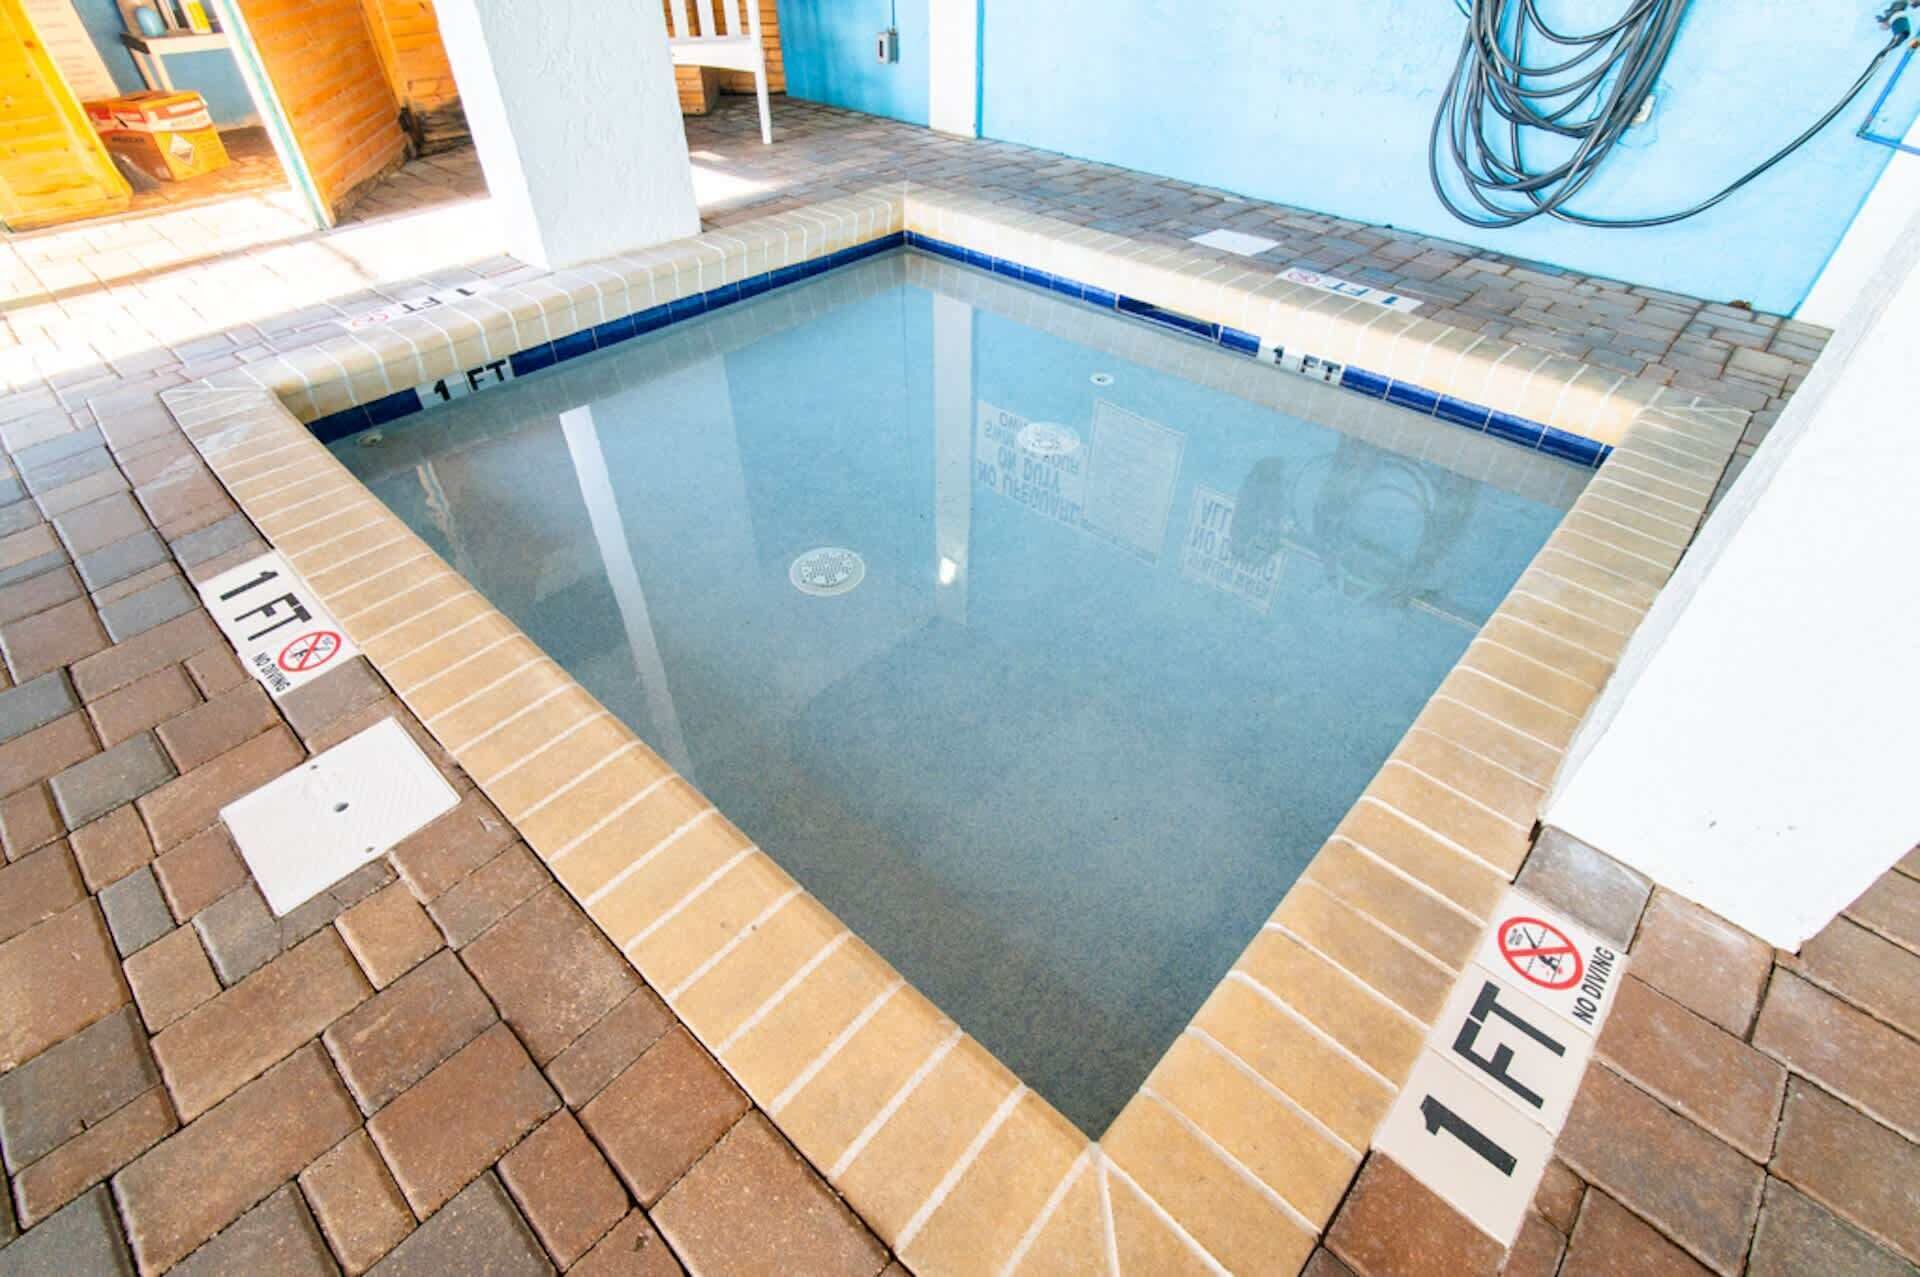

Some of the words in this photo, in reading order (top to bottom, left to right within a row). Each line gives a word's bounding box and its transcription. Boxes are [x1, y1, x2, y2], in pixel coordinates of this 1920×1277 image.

[433, 379, 451, 402] 1
[466, 358, 507, 391] FT
[1273, 345, 1285, 364] 1
[1300, 354, 1342, 381] FT
[220, 571, 279, 601] 1
[234, 592, 312, 641] FT
[252, 652, 271, 666] NO
[260, 664, 291, 692] DIVING
[1581, 946, 1615, 1000] DIVING
[1572, 997, 1598, 1025] NO
[1452, 980, 1566, 1110] FT
[1420, 1094, 1517, 1177] 1
